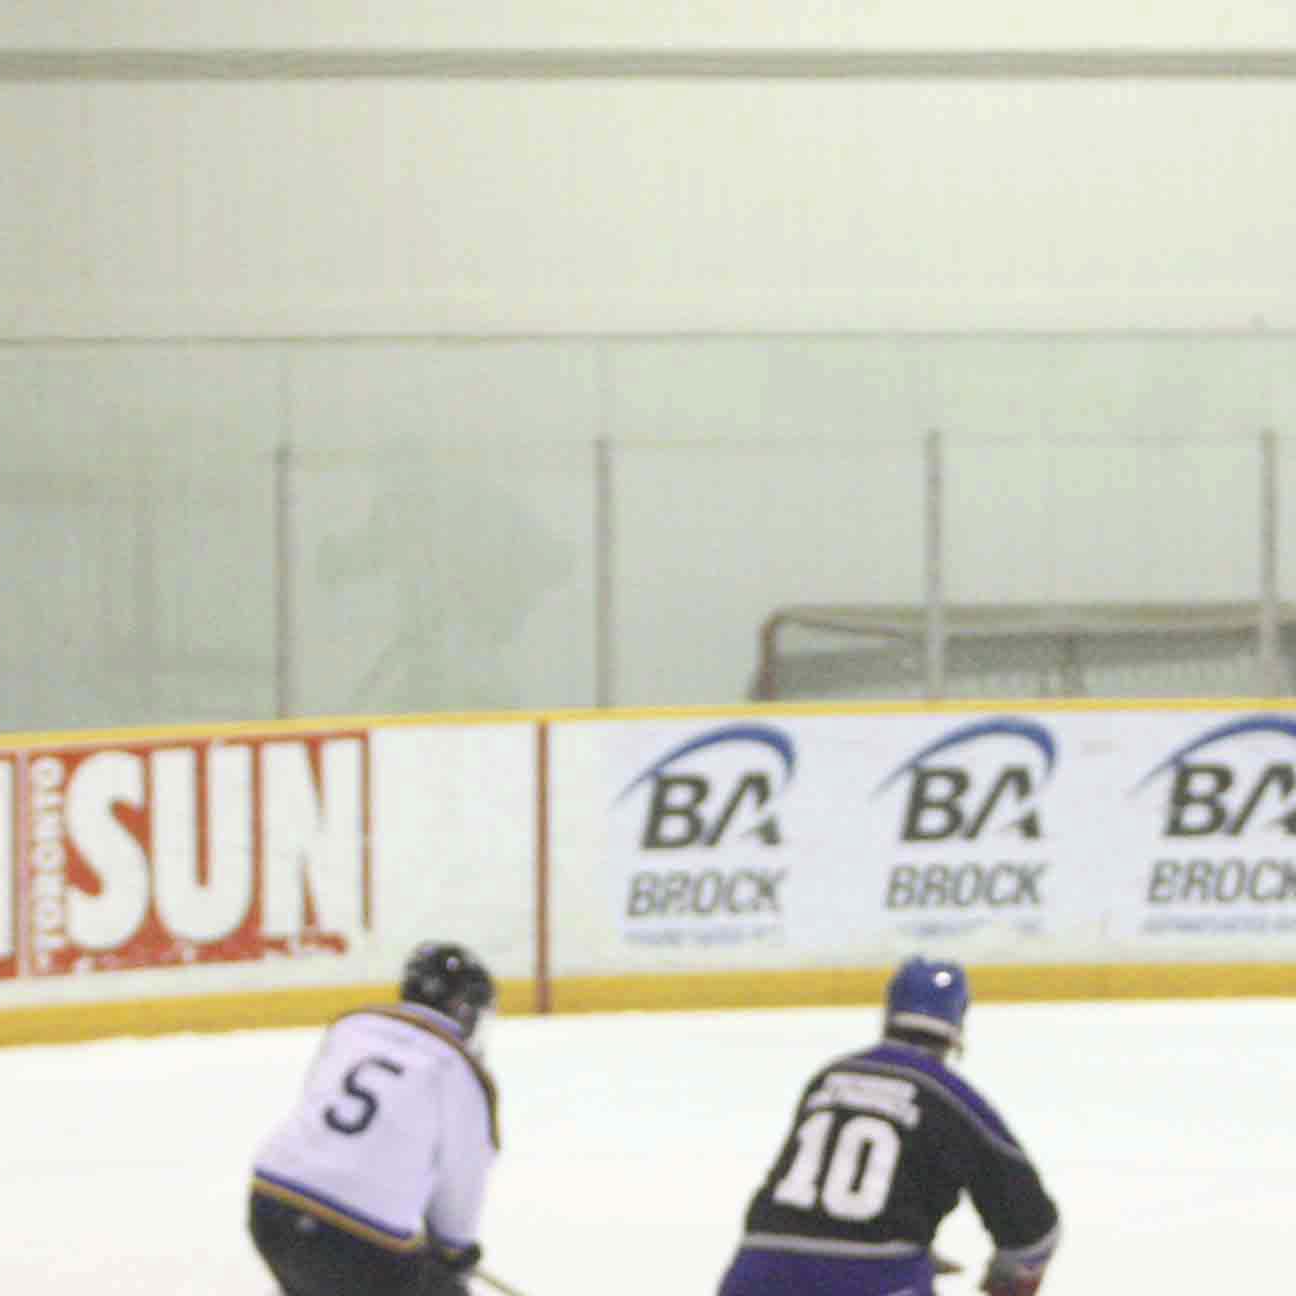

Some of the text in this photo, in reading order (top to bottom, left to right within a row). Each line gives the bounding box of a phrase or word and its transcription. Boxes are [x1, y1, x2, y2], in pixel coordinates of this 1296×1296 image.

[65, 737, 368, 952] SUN
[626, 868, 785, 919] BROCK
[885, 861, 1051, 912] BROCK
[322, 1056, 404, 1137] 5
[771, 1110, 902, 1222] 10
